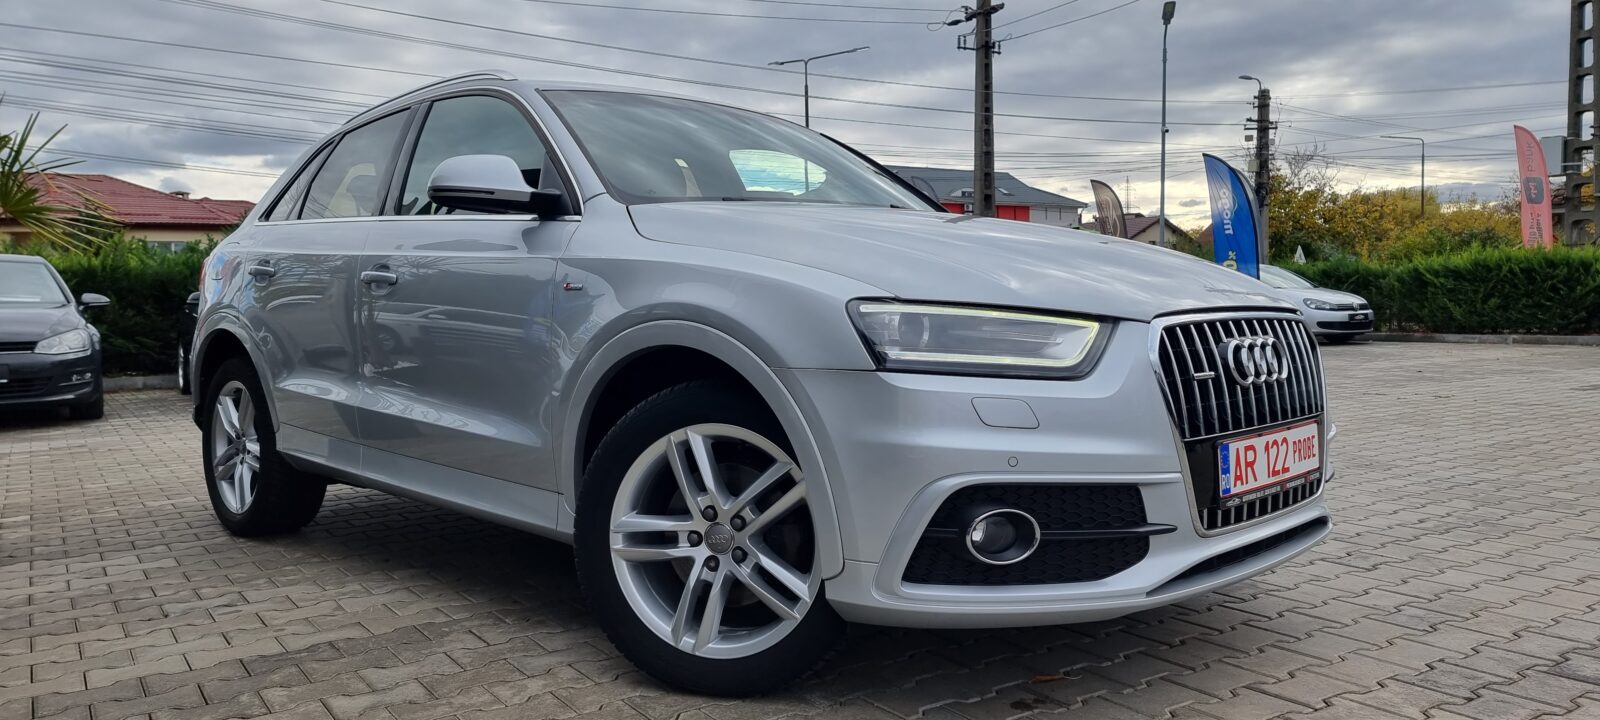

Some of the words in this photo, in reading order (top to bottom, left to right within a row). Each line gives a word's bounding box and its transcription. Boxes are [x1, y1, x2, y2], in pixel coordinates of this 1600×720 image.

[1233, 444, 1258, 488] AR
[1264, 436, 1290, 478] 122
[1292, 435, 1316, 464] PROBE
[1221, 473, 1231, 489] RO
